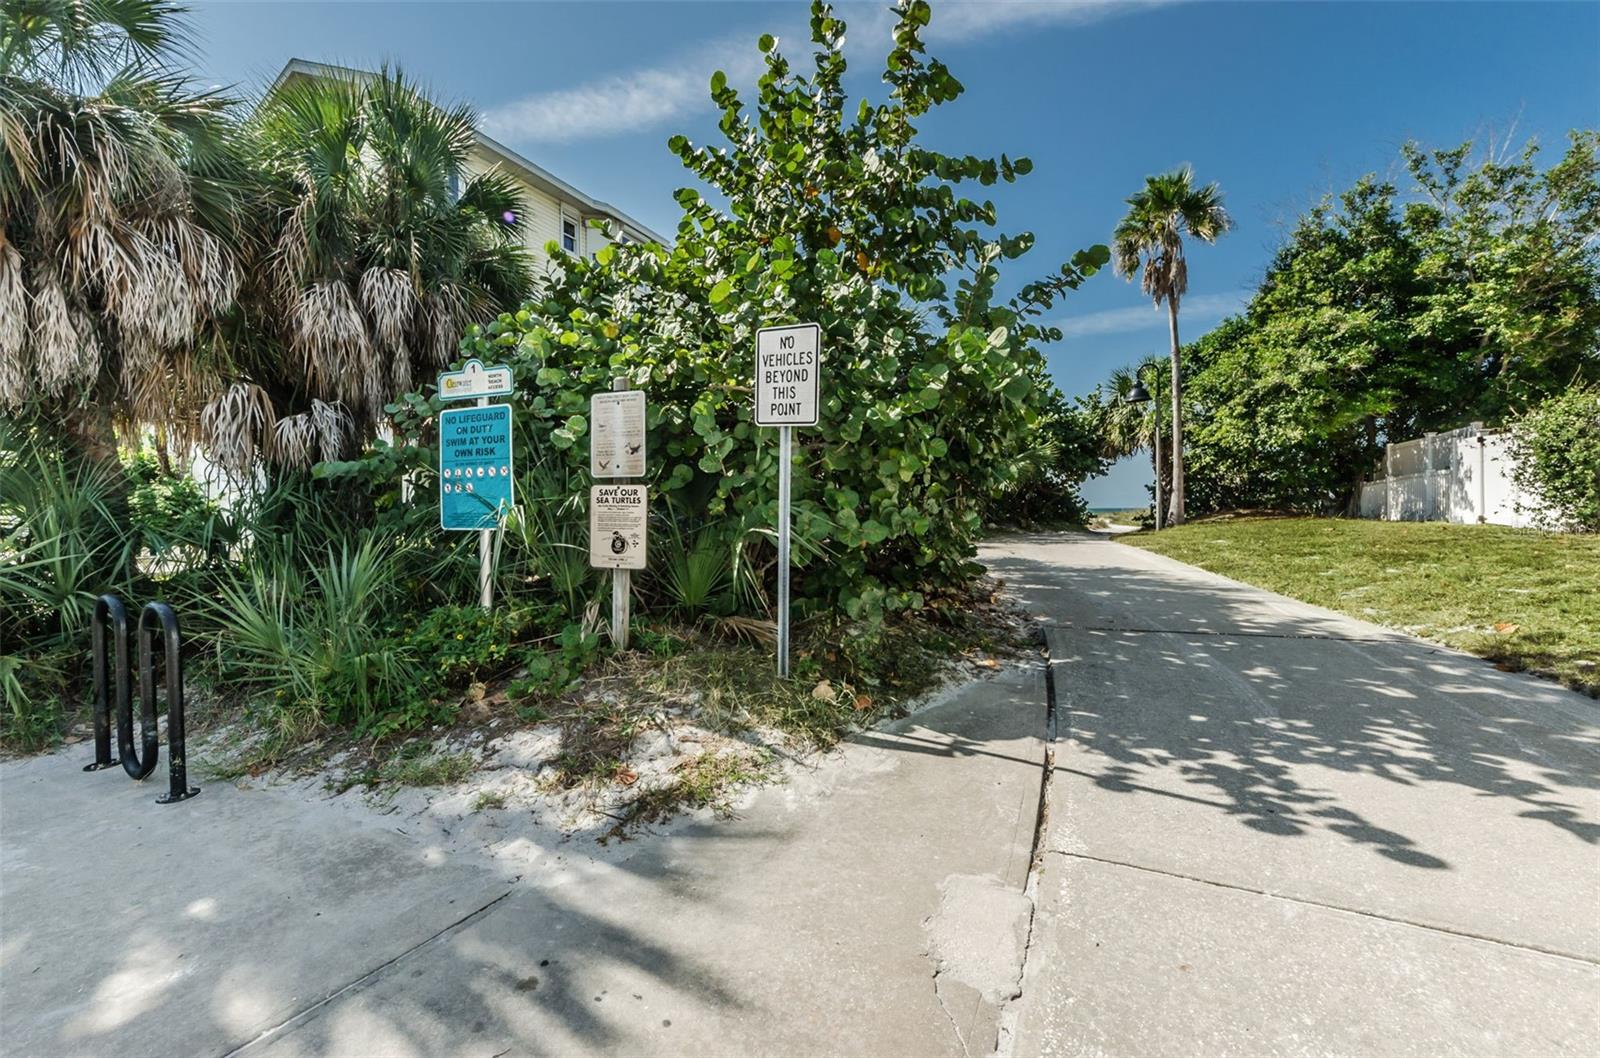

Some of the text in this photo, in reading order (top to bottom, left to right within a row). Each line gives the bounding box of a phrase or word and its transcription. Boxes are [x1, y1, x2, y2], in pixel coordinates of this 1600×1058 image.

[780, 335, 795, 350] NO
[762, 351, 813, 367] VEHICLES
[470, 364, 476, 374] 1
[765, 369, 809, 384] BEYOND
[772, 386, 796, 400] THIS
[770, 402, 802, 416] POINT
[445, 411, 506, 425] NO LIFEGUARD
[456, 424, 493, 435] ON DUTY
[446, 434, 506, 447] SWIM AT YOUR
[454, 446, 496, 458] OWN RISK
[599, 488, 639, 497] SAVE OUR
[596, 496, 642, 504] SEA TURTLES
